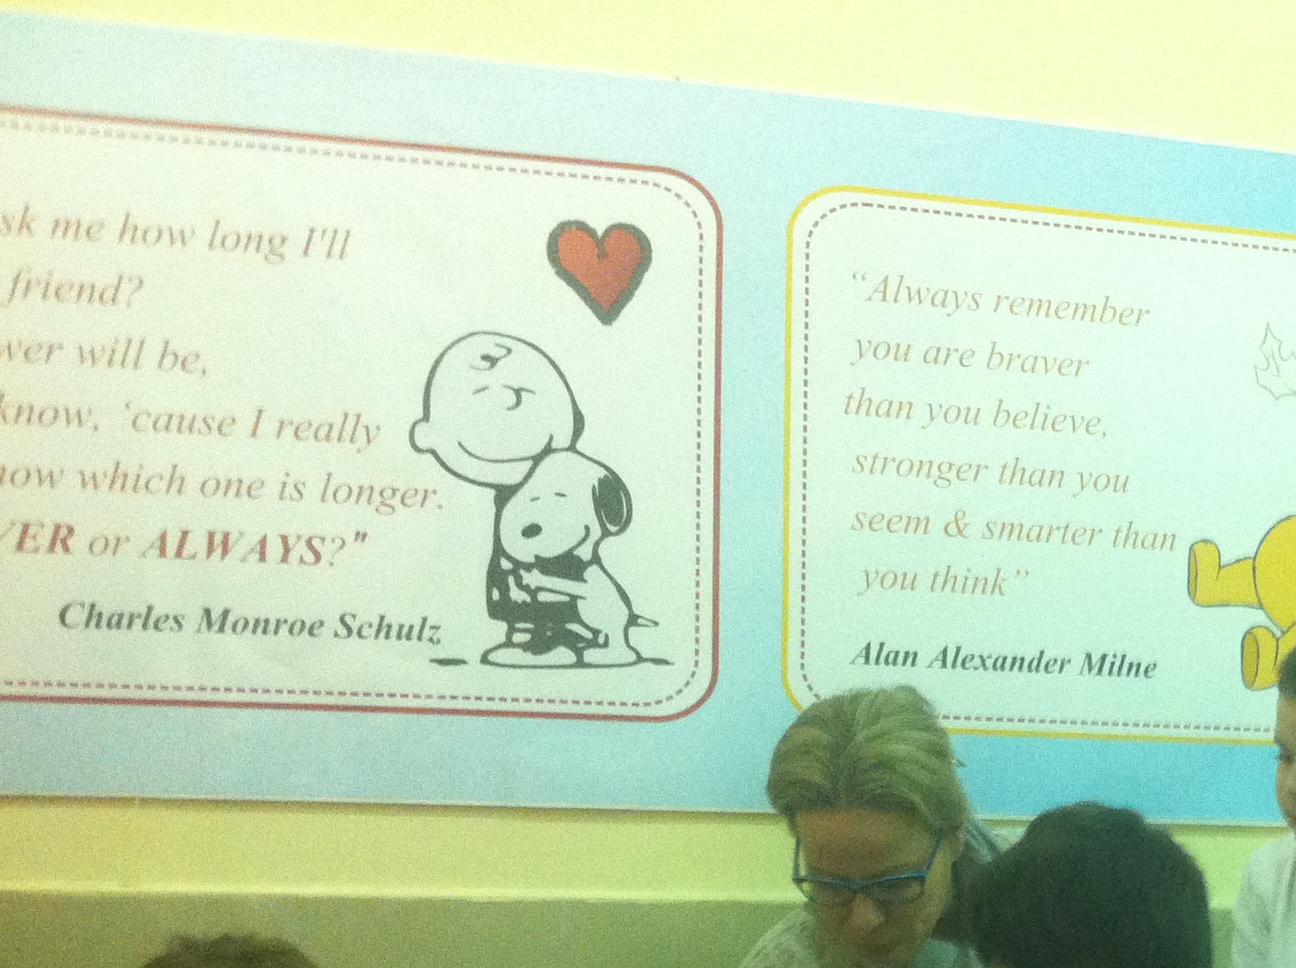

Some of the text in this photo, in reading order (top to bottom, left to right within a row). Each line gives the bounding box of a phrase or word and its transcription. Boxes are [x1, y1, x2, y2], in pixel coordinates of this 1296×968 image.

[50, 216, 106, 243] me
[117, 211, 196, 249] how
[209, 219, 288, 265] long
[302, 226, 352, 261] I'll
[1, 266, 144, 309] friend?
[994, 294, 1150, 327] remember
[76, 336, 146, 371] will
[157, 340, 207, 377] be,
[850, 337, 1090, 378] you are braver
[250, 407, 264, 440] I
[276, 411, 381, 454] really
[844, 386, 1107, 440] than you believe,
[78, 459, 187, 496] which
[200, 474, 265, 502] one
[279, 473, 307, 503] is
[321, 473, 444, 517] longer.
[852, 451, 1130, 498] stronger than you
[88, 533, 131, 557] or
[139, 526, 369, 569] ALWAYS?"
[851, 508, 1177, 553] seem & smarter than
[857, 567, 918, 597] you
[58, 601, 443, 647] Charles Monroe Schulz
[850, 640, 1158, 680] Alan Alexander Milne
